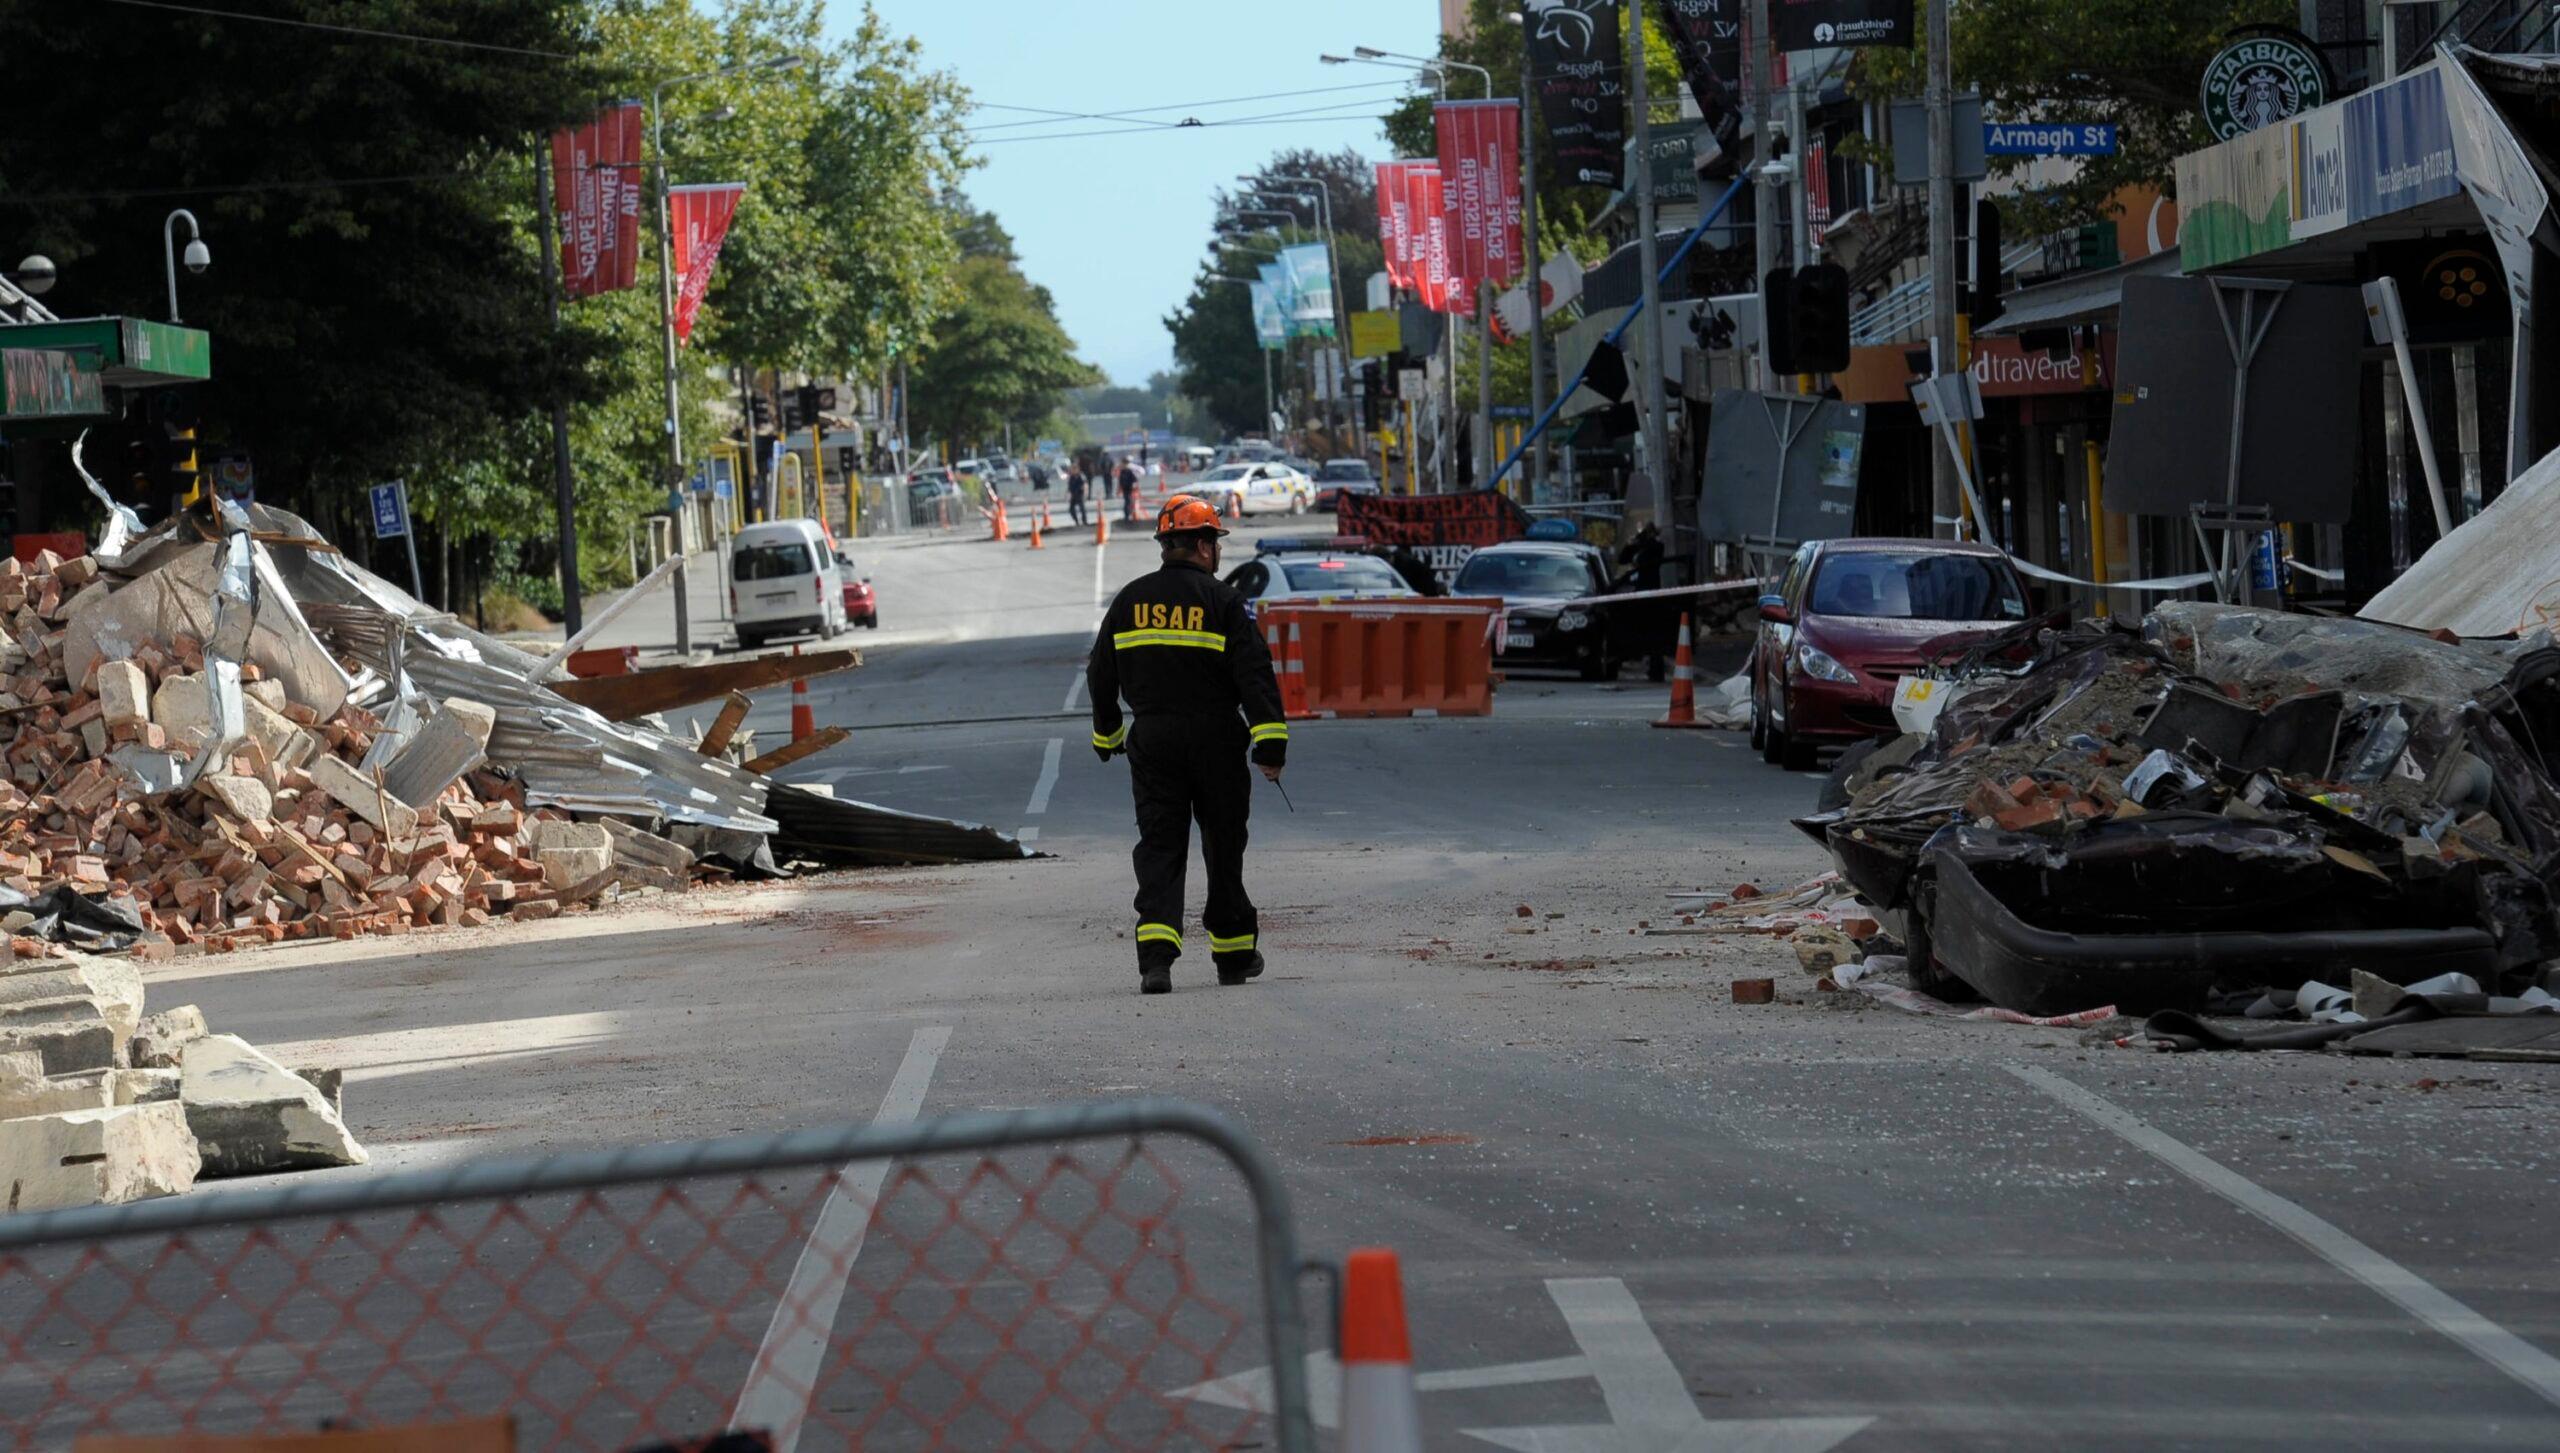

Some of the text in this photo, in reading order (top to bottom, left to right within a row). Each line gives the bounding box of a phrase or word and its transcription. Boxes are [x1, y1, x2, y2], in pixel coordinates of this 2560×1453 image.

[2209, 43, 2317, 95] STARBUCKS
[1989, 126, 2107, 152] Armagh St
[621, 184, 639, 217] ART
[560, 210, 574, 245] SEE
[1411, 544, 1472, 569] THIS
[1134, 603, 1204, 631] USAR
